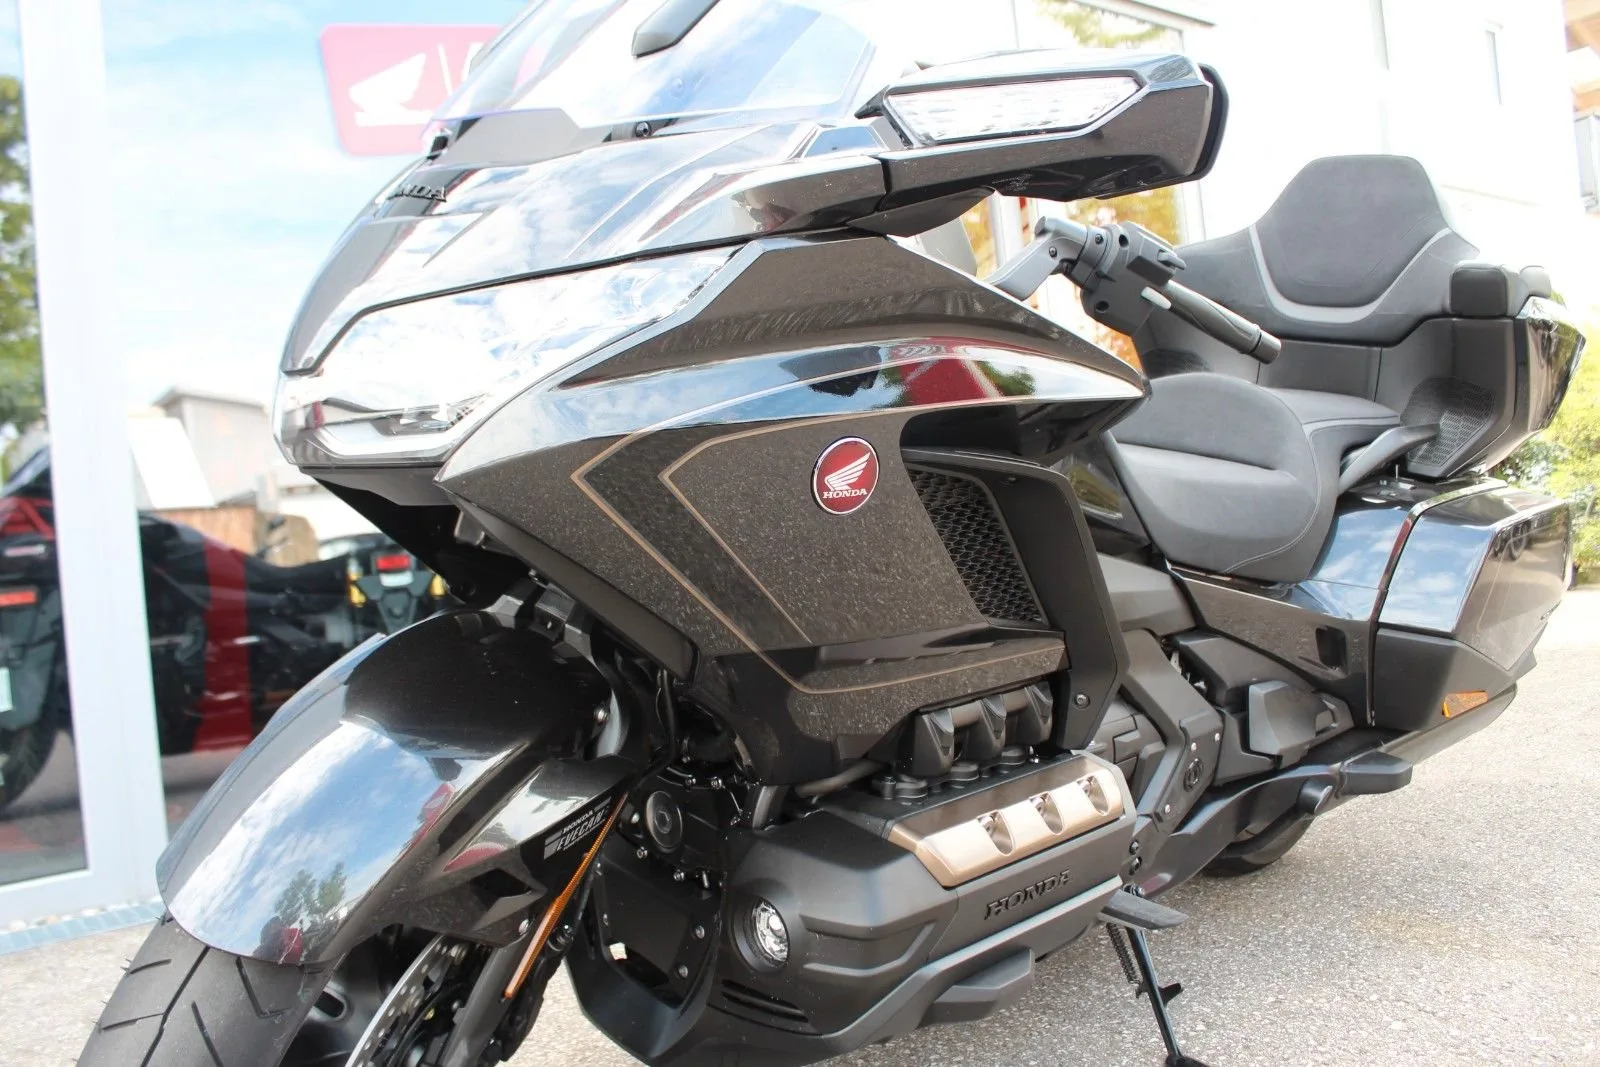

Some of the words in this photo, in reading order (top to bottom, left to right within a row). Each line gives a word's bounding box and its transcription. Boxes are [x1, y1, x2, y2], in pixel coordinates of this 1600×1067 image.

[822, 488, 868, 499] HONDA
[563, 809, 594, 834] HONDA
[983, 868, 1071, 920] HONDA
